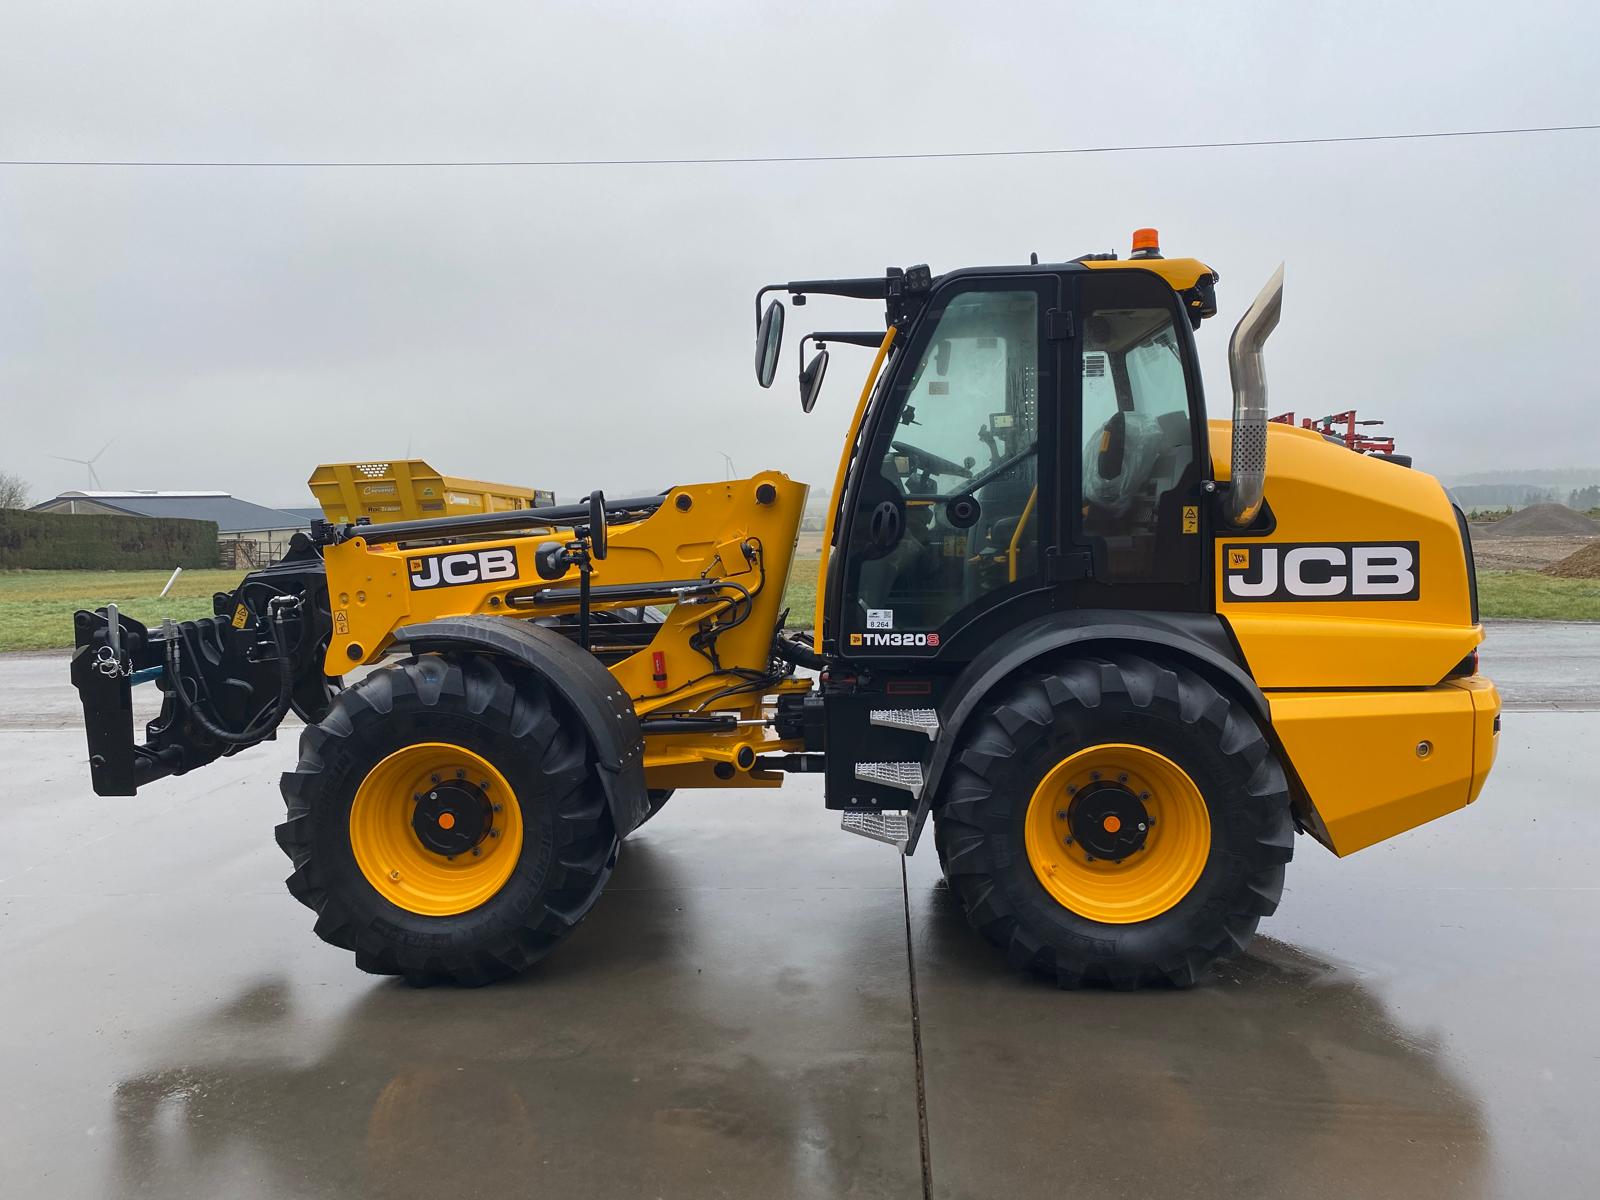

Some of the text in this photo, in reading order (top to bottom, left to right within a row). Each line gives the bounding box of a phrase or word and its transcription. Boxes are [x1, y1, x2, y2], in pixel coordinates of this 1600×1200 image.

[412, 549, 516, 587] JCB
[1228, 546, 1416, 597] JCB
[863, 633, 940, 646] TM320S
